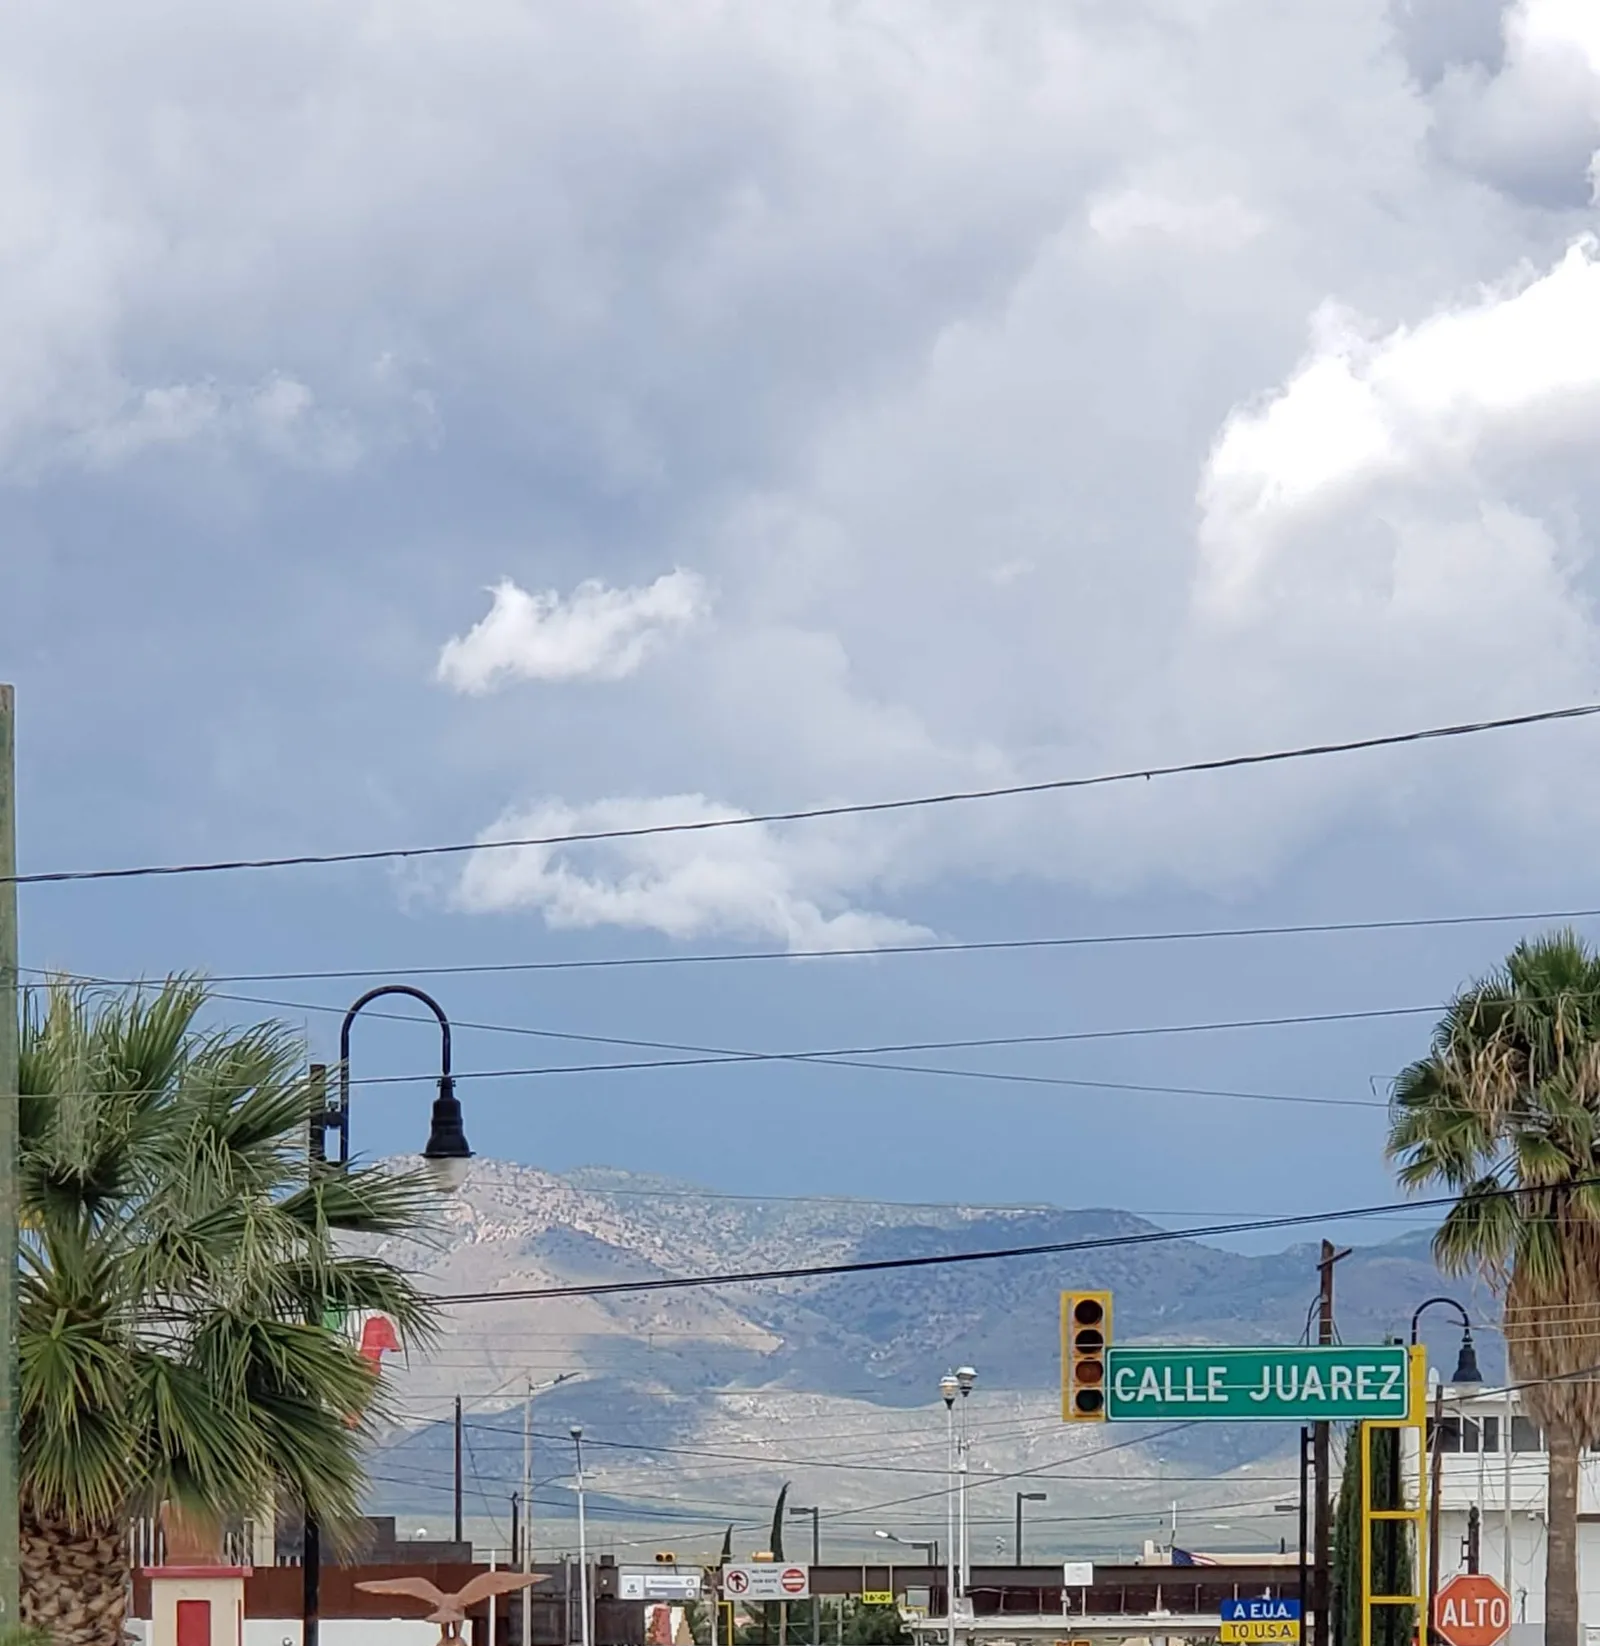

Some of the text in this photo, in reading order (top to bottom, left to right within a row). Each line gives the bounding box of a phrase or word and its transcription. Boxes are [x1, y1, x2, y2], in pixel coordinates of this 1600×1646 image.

[1115, 1365, 1401, 1402] CALLE JUAREZ
[1233, 1603, 1246, 1619] A
[1441, 1598, 1506, 1628] ALTO
[1231, 1624, 1249, 1638] TO
